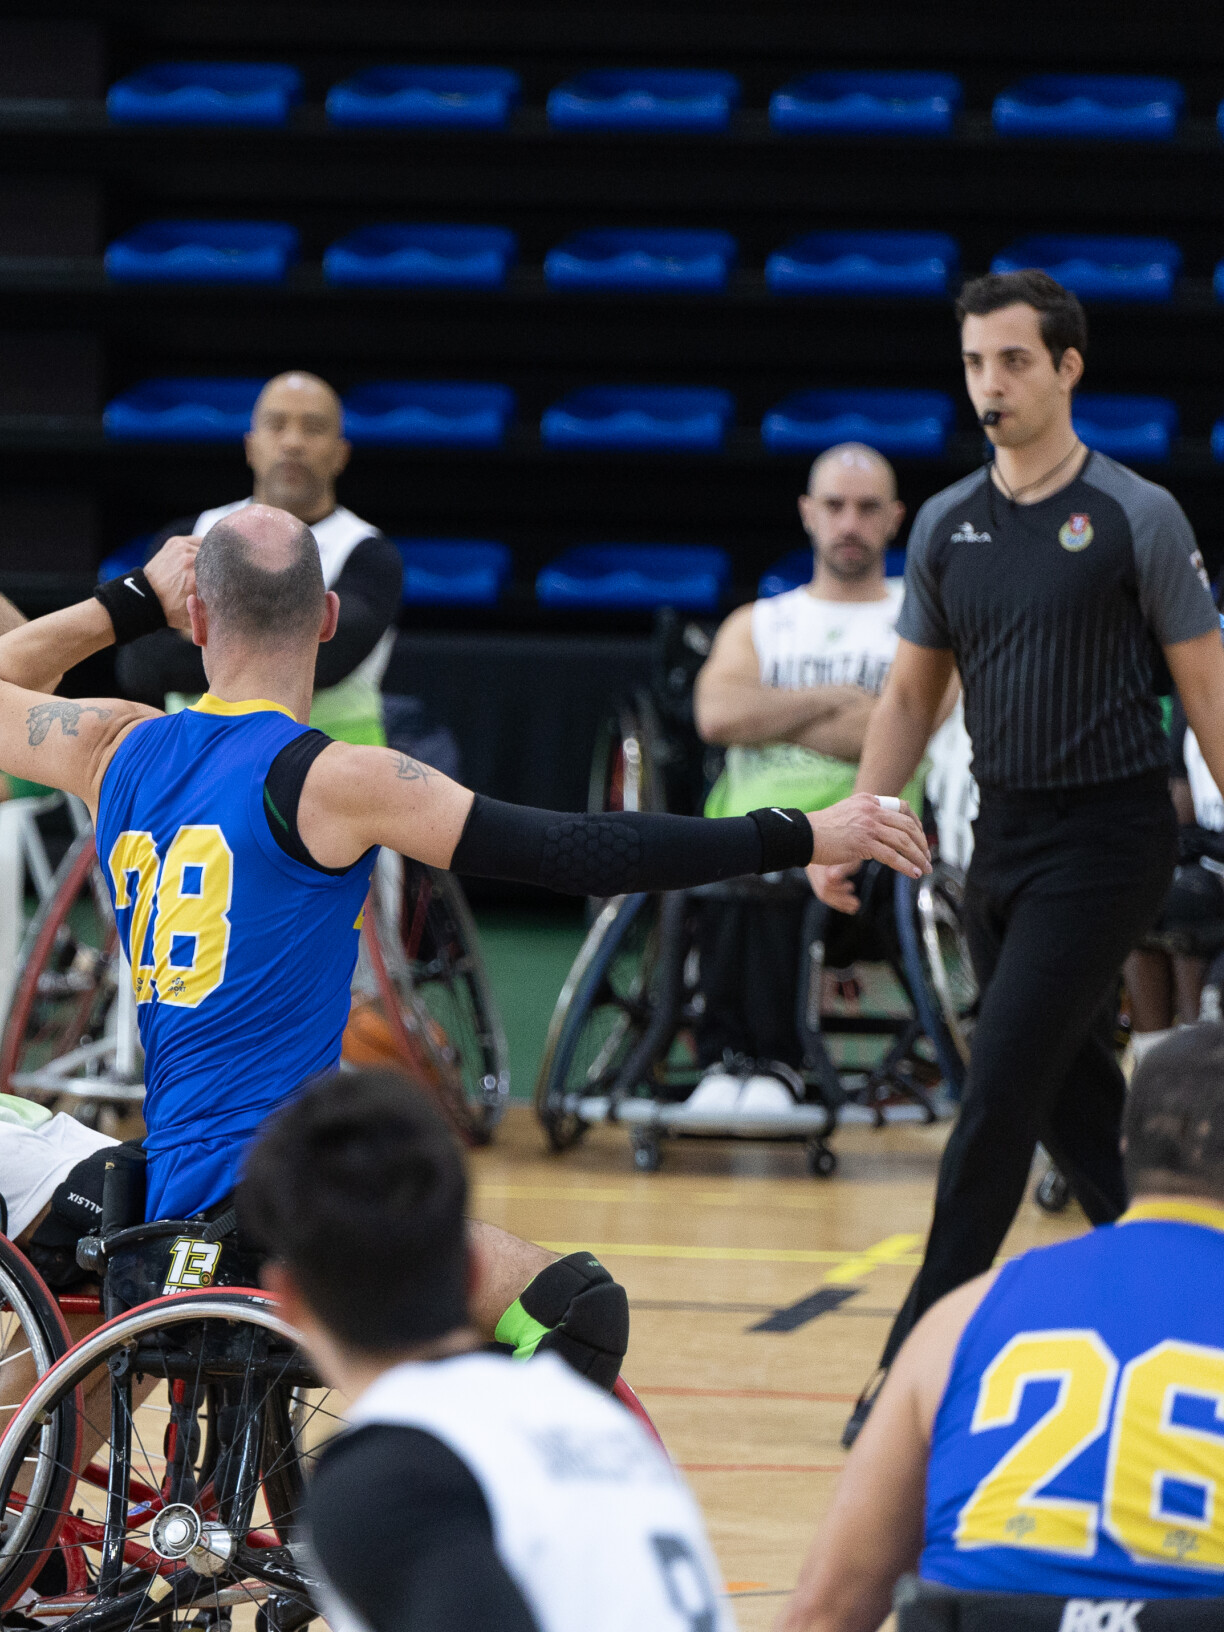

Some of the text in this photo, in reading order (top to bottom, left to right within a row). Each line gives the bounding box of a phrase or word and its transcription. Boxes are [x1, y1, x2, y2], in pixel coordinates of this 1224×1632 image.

[108, 824, 234, 1009] 28
[67, 1192, 103, 1214] ALLSIX
[169, 1238, 222, 1287] 13
[953, 1329, 1224, 1573] 26
